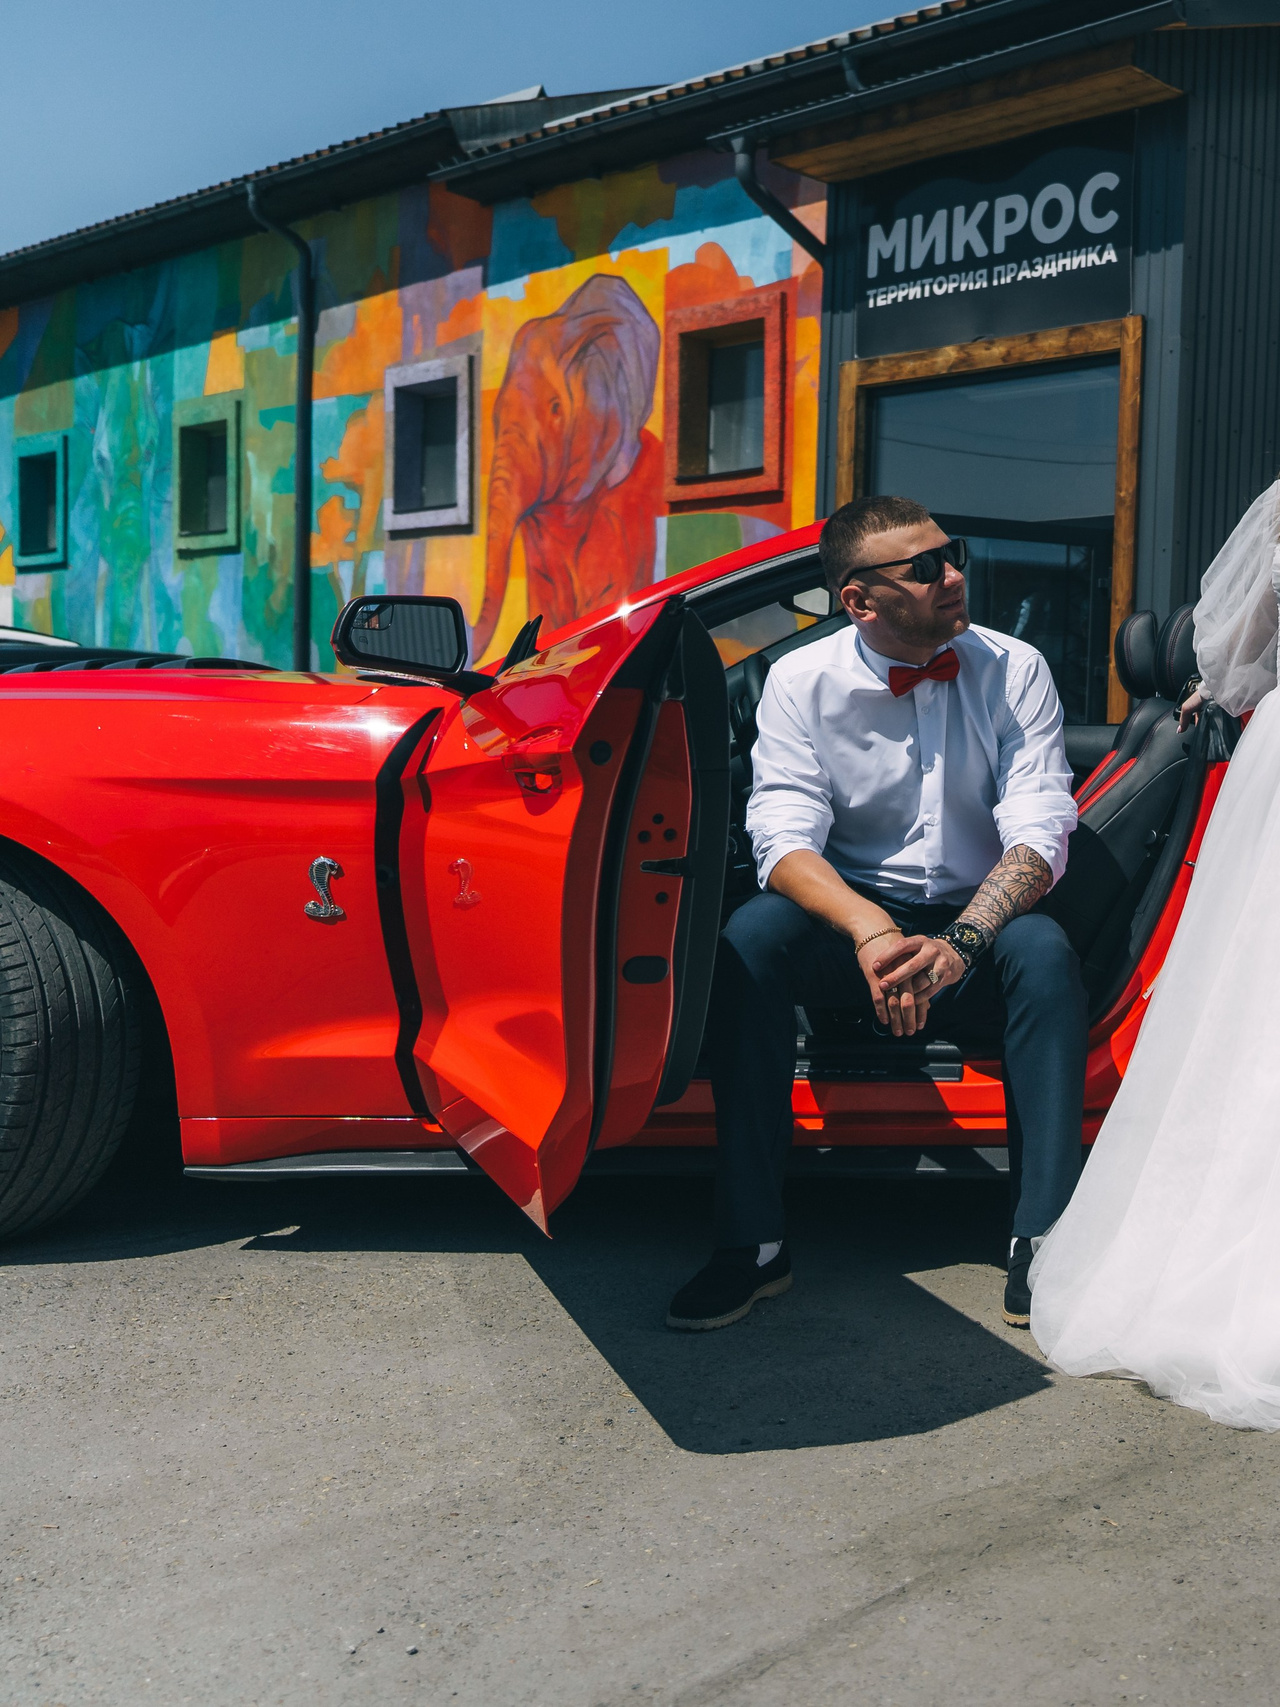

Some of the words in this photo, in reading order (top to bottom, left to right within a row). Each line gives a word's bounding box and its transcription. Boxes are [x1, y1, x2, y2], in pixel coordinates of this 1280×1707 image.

[867, 172, 1120, 278] МИКРОС
[867, 268, 987, 308] ТЕРРИТОРИЯ
[992, 243, 1117, 286] ПРАЗДНИКА
